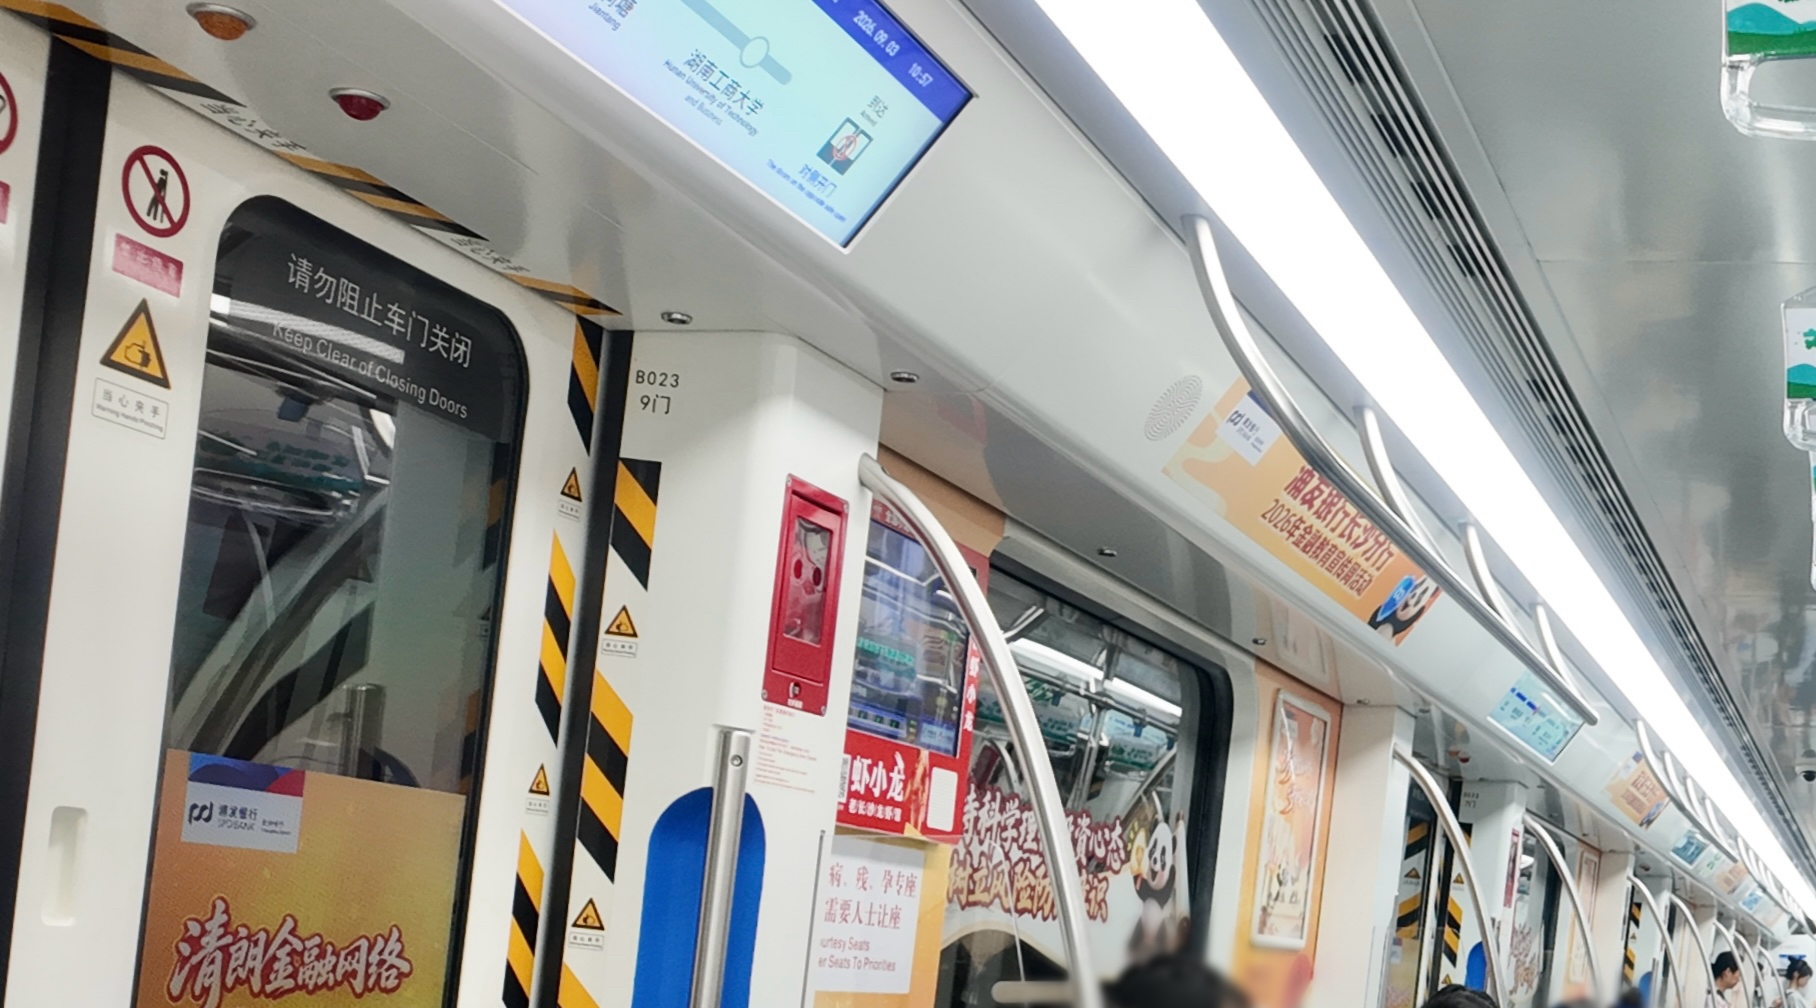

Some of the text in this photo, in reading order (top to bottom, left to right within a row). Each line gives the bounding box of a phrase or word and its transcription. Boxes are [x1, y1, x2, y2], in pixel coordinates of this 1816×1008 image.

[663, 59, 686, 81] Hunan
[685, 76, 718, 106] University
[684, 49, 764, 116] 湖南工商大学
[908, 63, 933, 87] 10:57
[288, 253, 472, 368] 请勿阻止车门关闭
[273, 322, 468, 419] Keep Clear of Closing Doors
[635, 370, 680, 388] B023
[640, 394, 671, 414] 9门
[949, 851, 1108, 922] 树立风险防识
[824, 897, 902, 929] 需要人士让座
[848, 936, 870, 952] Seats
[828, 955, 851, 969] Seats
